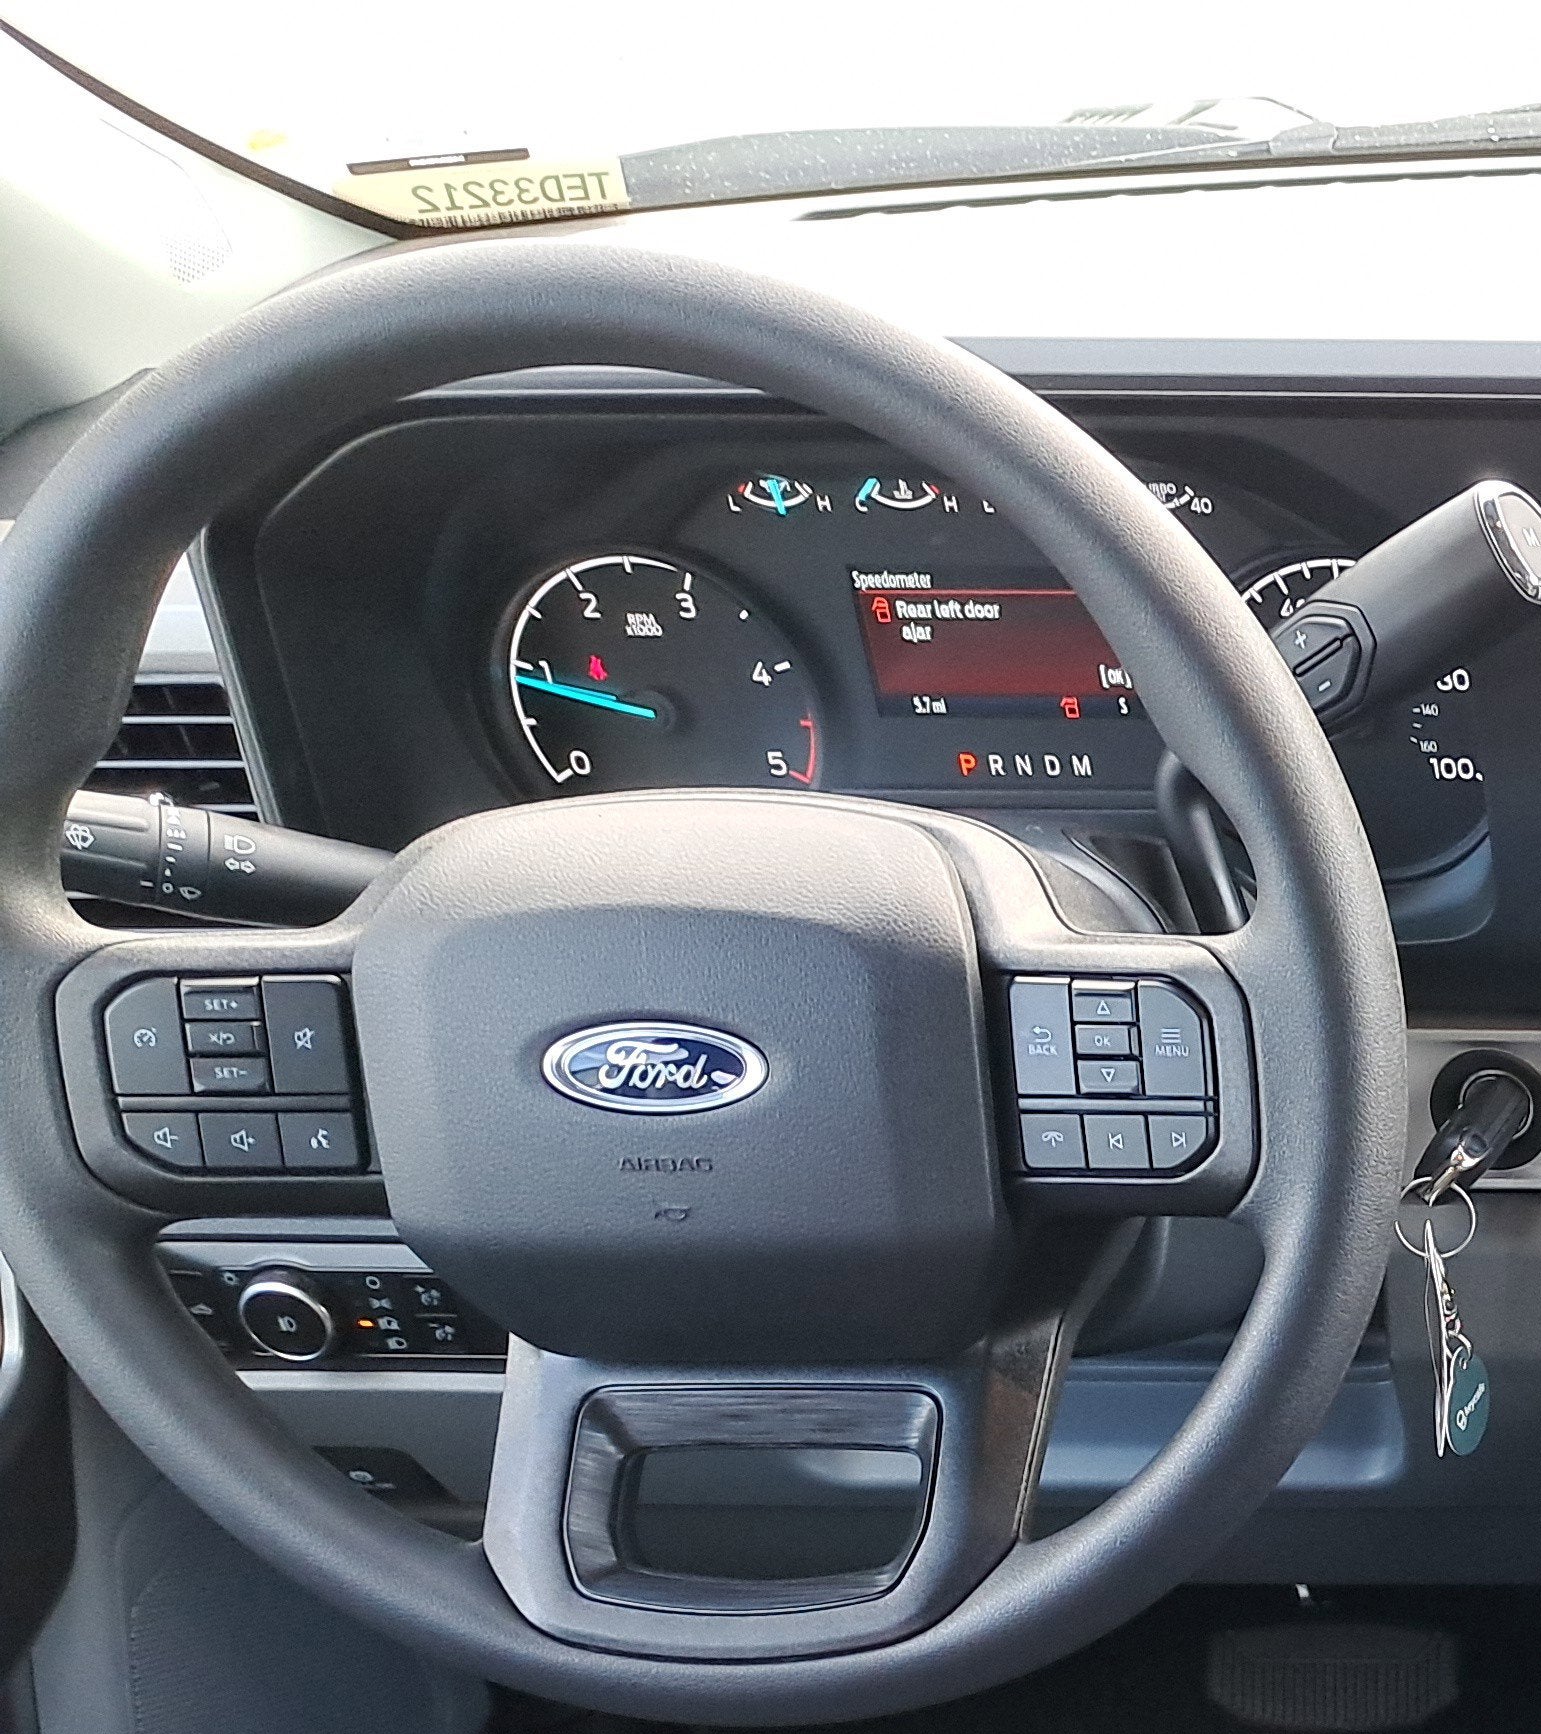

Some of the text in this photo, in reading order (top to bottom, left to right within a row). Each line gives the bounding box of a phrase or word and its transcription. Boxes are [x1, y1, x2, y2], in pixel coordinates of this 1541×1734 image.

[816, 495, 832, 512] H
[944, 495, 958, 513] H
[1190, 497, 1213, 514] 40
[852, 571, 932, 591] Speedometer
[579, 592, 601, 618] 2
[675, 593, 696, 618] 3
[895, 600, 1001, 619] Rear left door
[902, 622, 931, 643] ajar
[538, 660, 551, 684] 1
[752, 661, 772, 686] 4
[568, 749, 590, 775] 0
[766, 751, 788, 776] 5
[959, 752, 1092, 776] P R N D M
[1429, 757, 1475, 780] 100
[1028, 1044, 1058, 1056] BACK
[1094, 1035, 1111, 1047] OK
[1155, 1045, 1189, 1058] MENU
[597, 1040, 708, 1090] Ford
